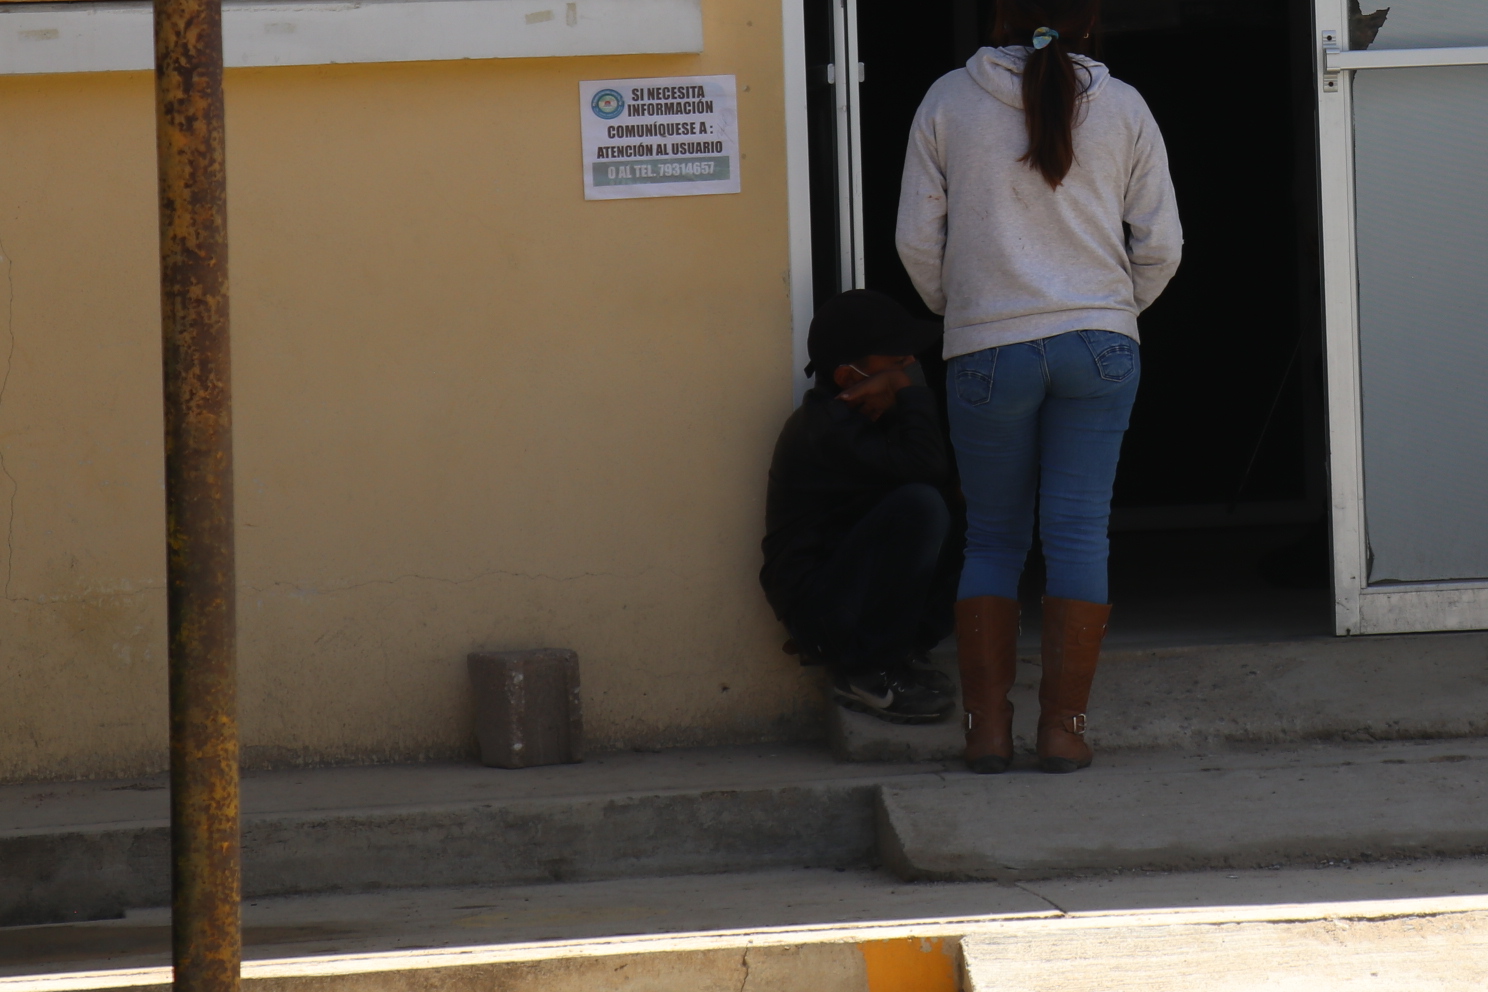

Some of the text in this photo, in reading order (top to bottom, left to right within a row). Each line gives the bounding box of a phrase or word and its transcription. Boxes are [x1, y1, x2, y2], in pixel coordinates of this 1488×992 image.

[631, 86, 705, 101] SI NECESITA
[627, 99, 714, 117] INFORMACIÓN
[607, 122, 696, 139] COMUNÍQUESE
[699, 121, 707, 134] A
[597, 141, 723, 159] ATENCIÓN AL USUARIO
[619, 165, 632, 179] AL
[634, 164, 657, 177] TEL.
[658, 161, 715, 177] 79314657
